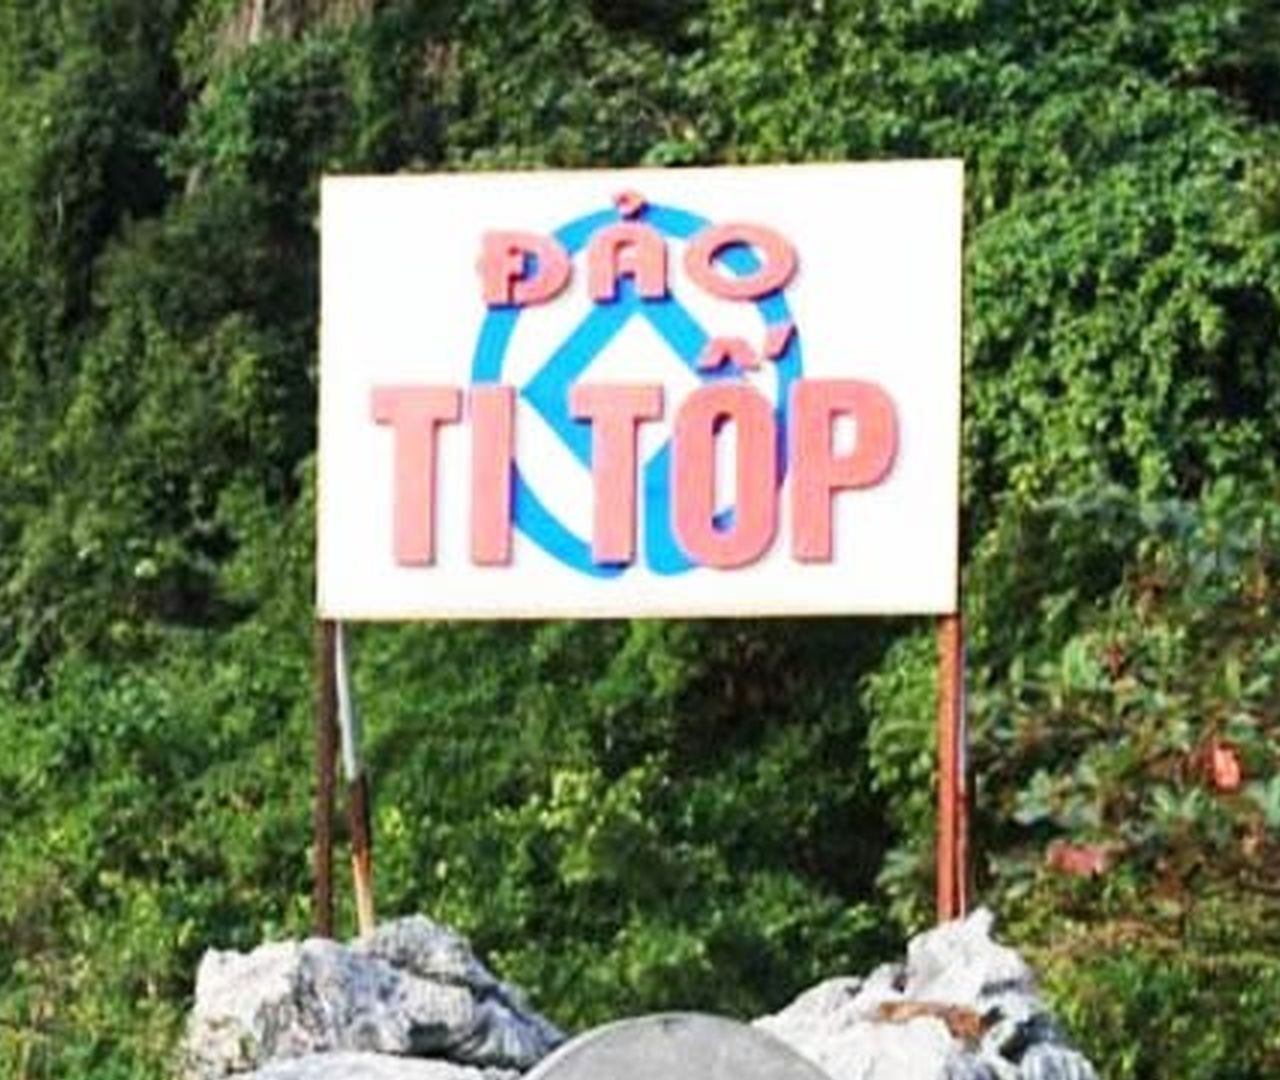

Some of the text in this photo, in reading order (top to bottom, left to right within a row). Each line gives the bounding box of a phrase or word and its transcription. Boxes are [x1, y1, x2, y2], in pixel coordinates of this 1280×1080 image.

[476, 190, 799, 308] ĐẢO
[370, 322, 901, 570] TI TỐP
